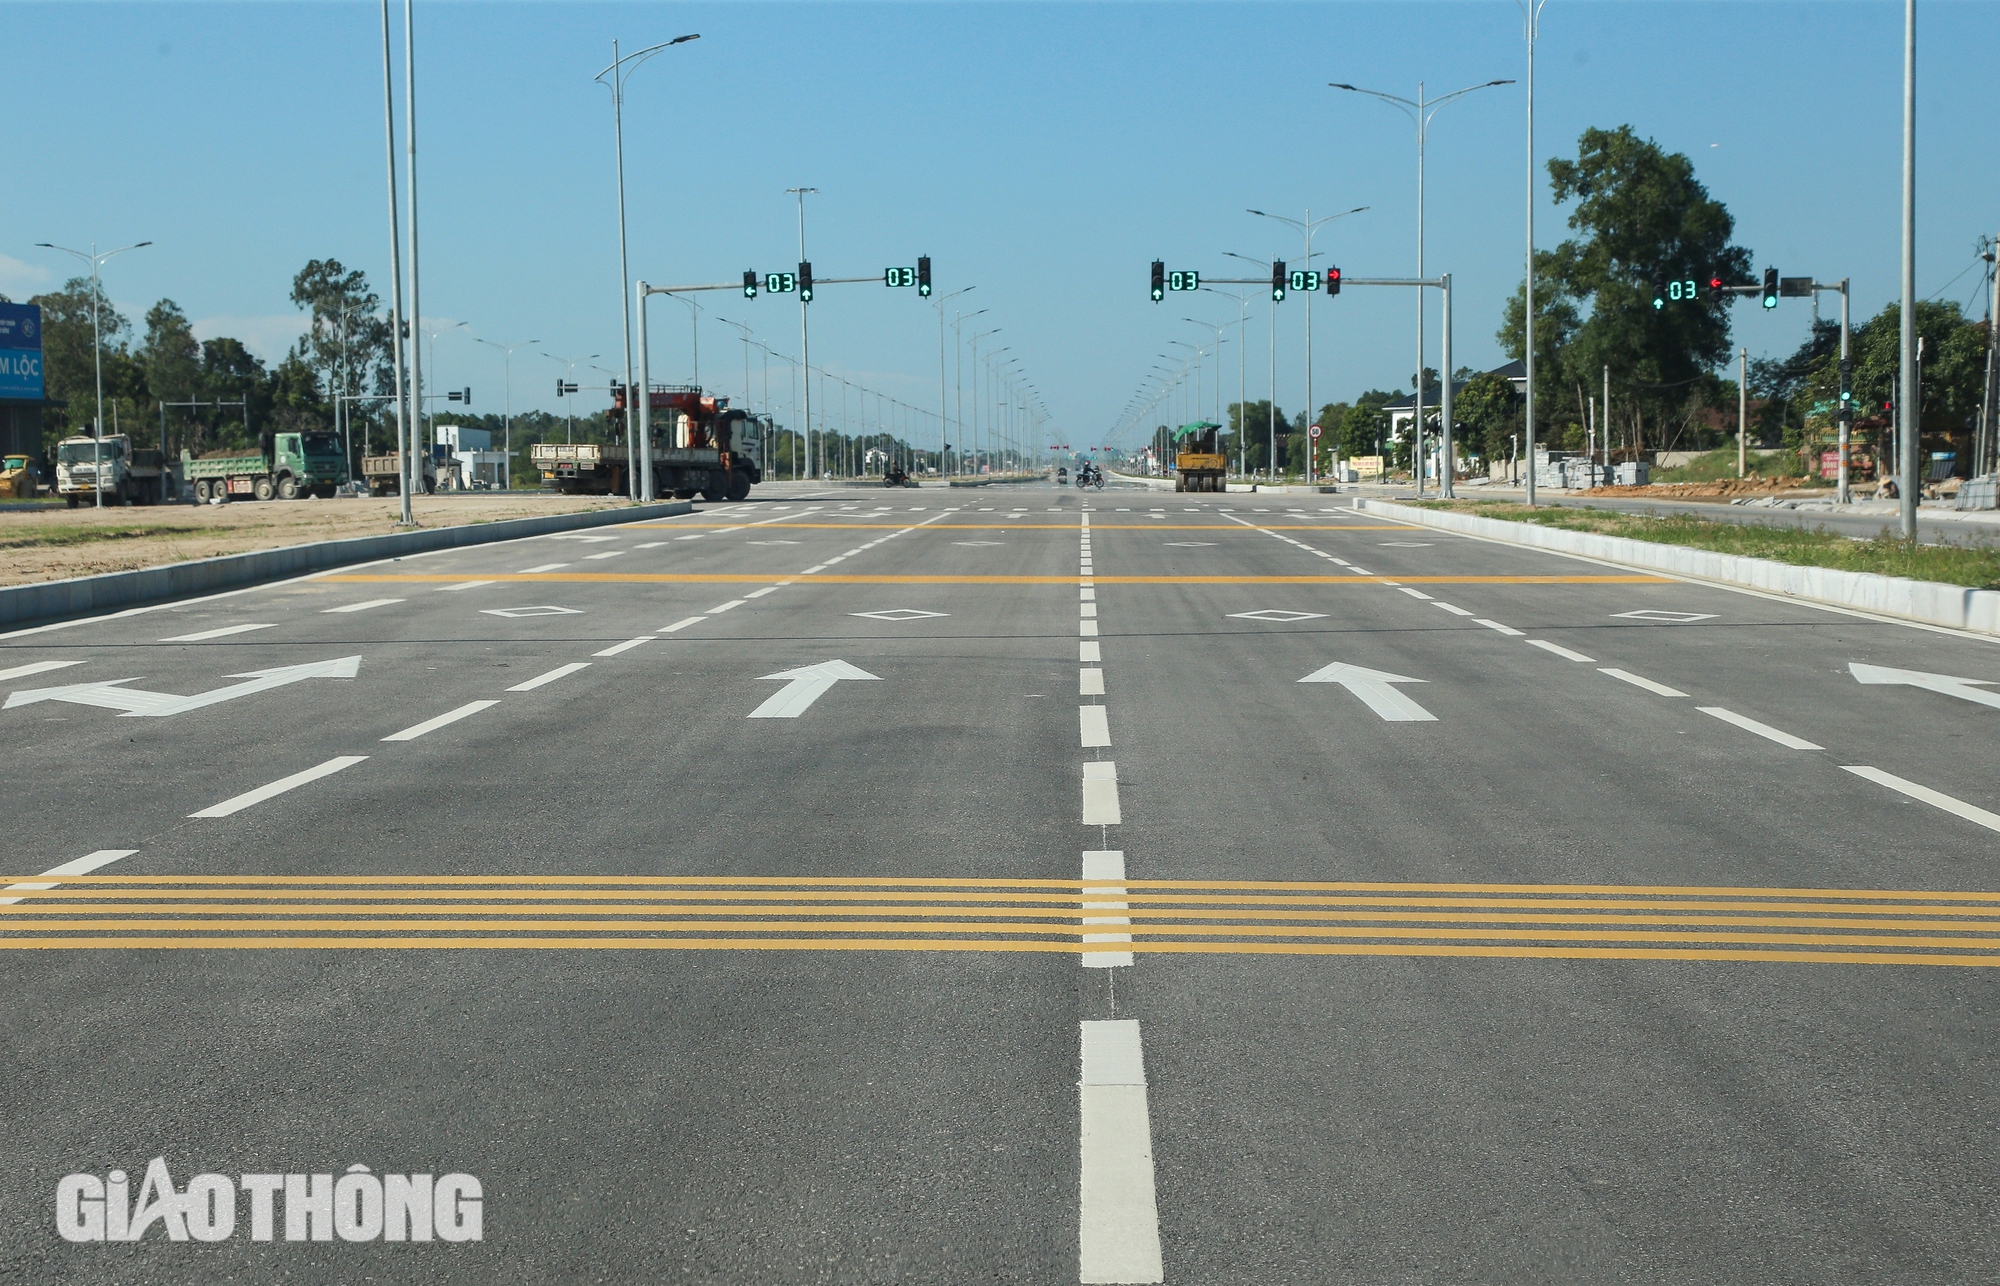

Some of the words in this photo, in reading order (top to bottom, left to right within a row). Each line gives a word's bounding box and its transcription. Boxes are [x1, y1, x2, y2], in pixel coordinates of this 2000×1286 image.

[768, 273, 794, 293] 03
[887, 268, 913, 287] 03
[1171, 272, 1197, 291] 03
[1291, 272, 1318, 291] 03
[1669, 280, 1696, 300] 03
[13, 354, 39, 381] LỘC
